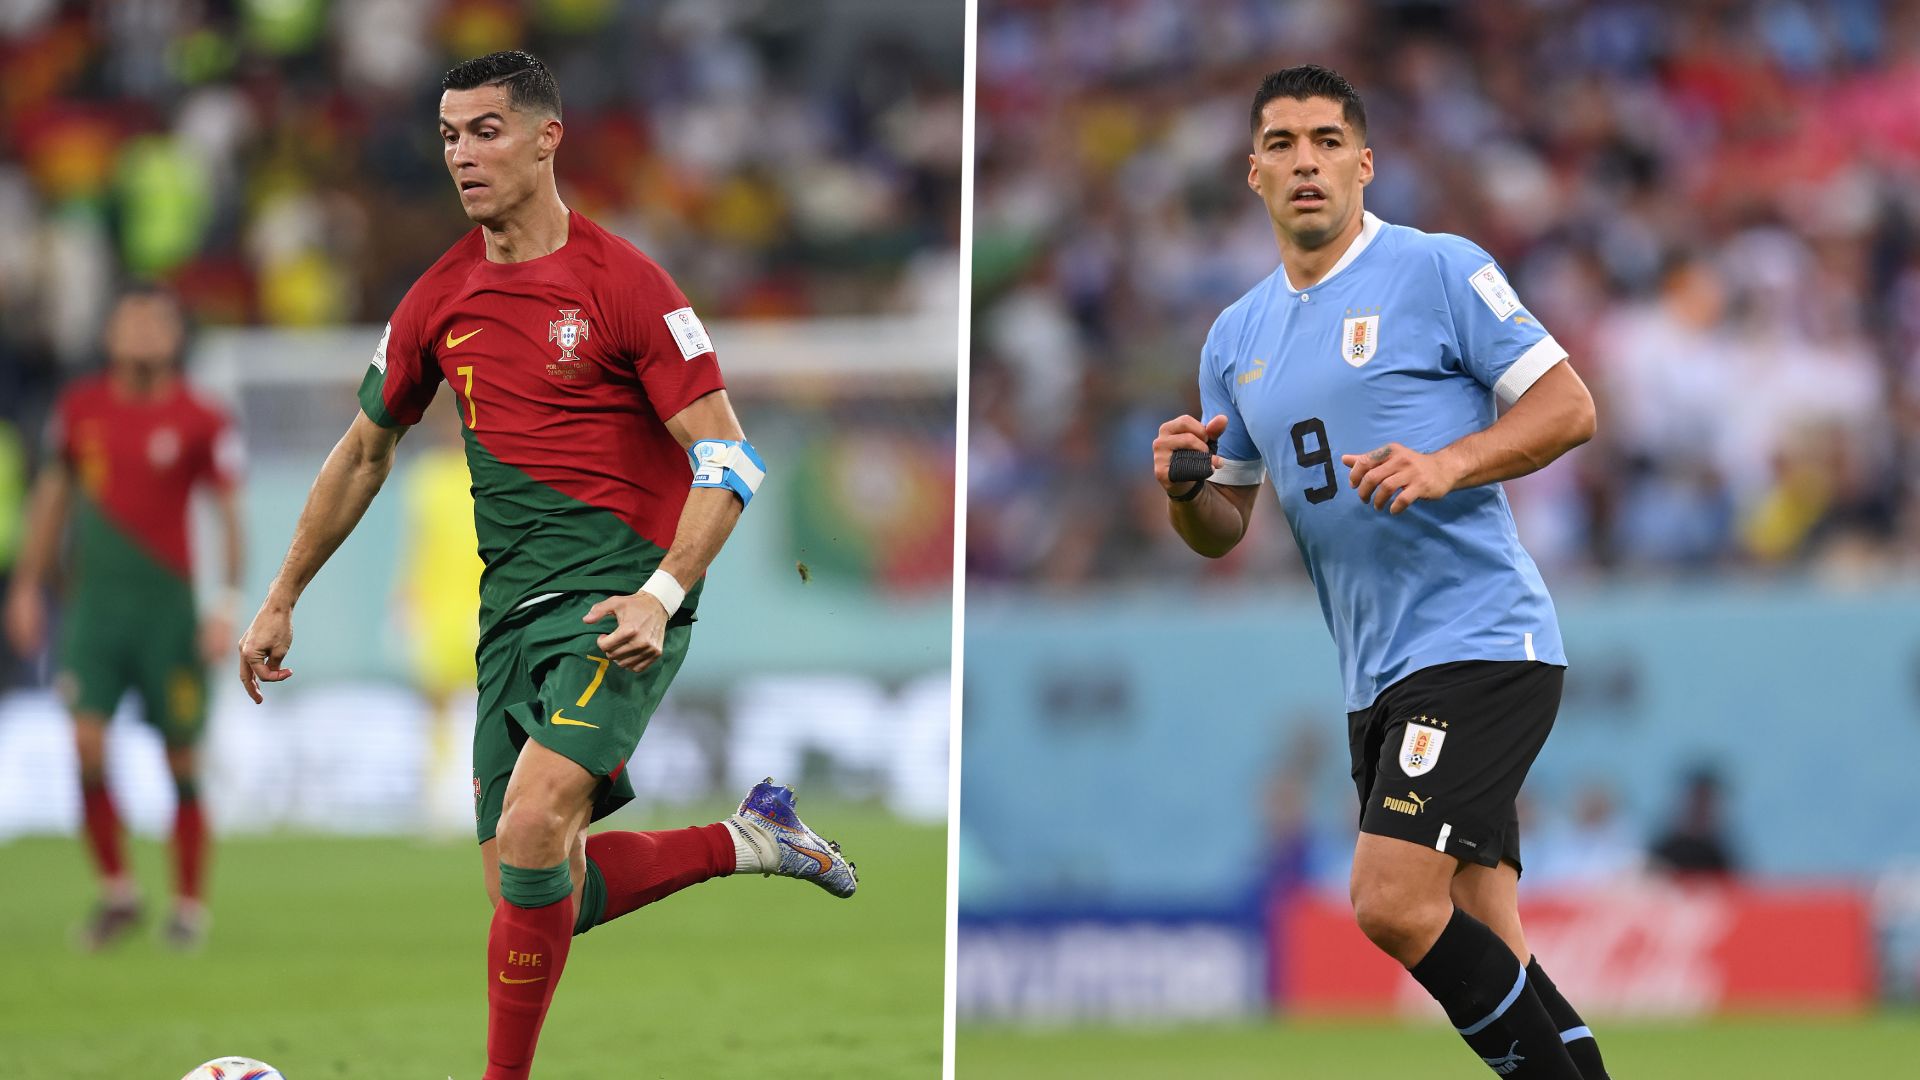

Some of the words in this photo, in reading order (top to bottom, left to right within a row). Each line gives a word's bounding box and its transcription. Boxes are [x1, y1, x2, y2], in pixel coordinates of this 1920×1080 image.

[457, 366, 476, 429] 7
[1290, 417, 1338, 504] 9
[576, 654, 609, 708] 7
[1383, 796, 1418, 816] PUMA
